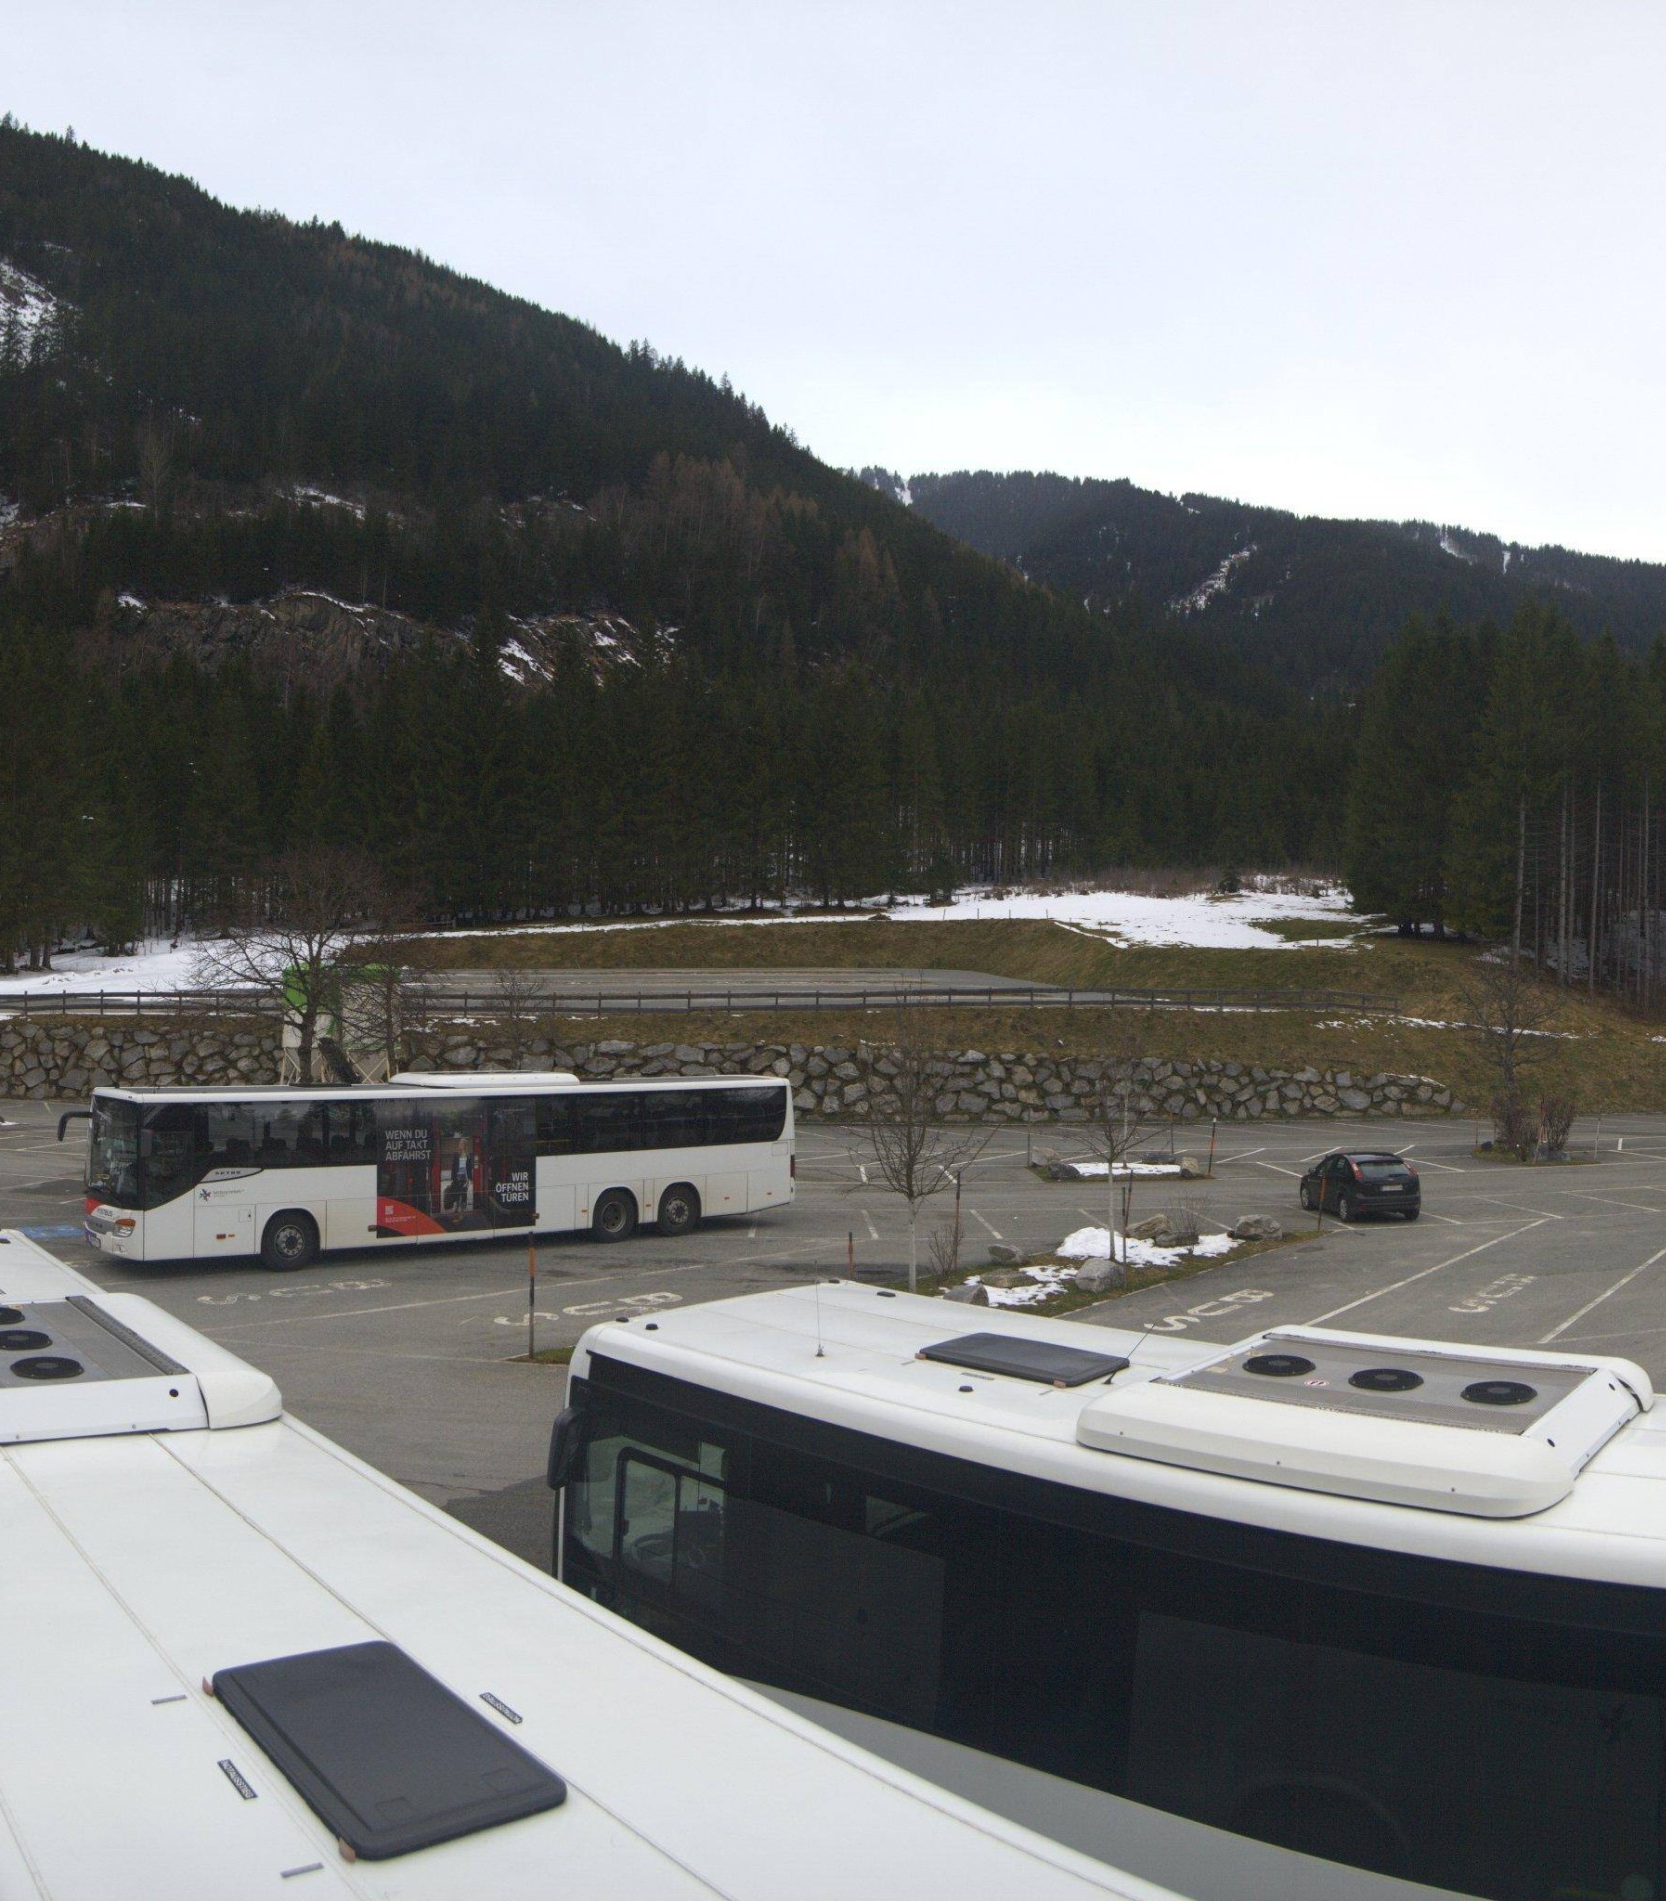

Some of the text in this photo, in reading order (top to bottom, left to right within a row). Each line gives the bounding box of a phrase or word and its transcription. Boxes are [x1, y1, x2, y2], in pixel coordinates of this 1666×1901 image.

[385, 1129, 428, 1140] WENN DU
[385, 1139, 428, 1150] AUF TAKT
[511, 1171, 529, 1181] WIR
[495, 1181, 529, 1193] ÖFFNEN
[501, 1191, 529, 1202] TÜREN
[197, 1278, 392, 1306] BUS
[493, 1291, 684, 1327] BUS
[1143, 1288, 1275, 1332] BUS
